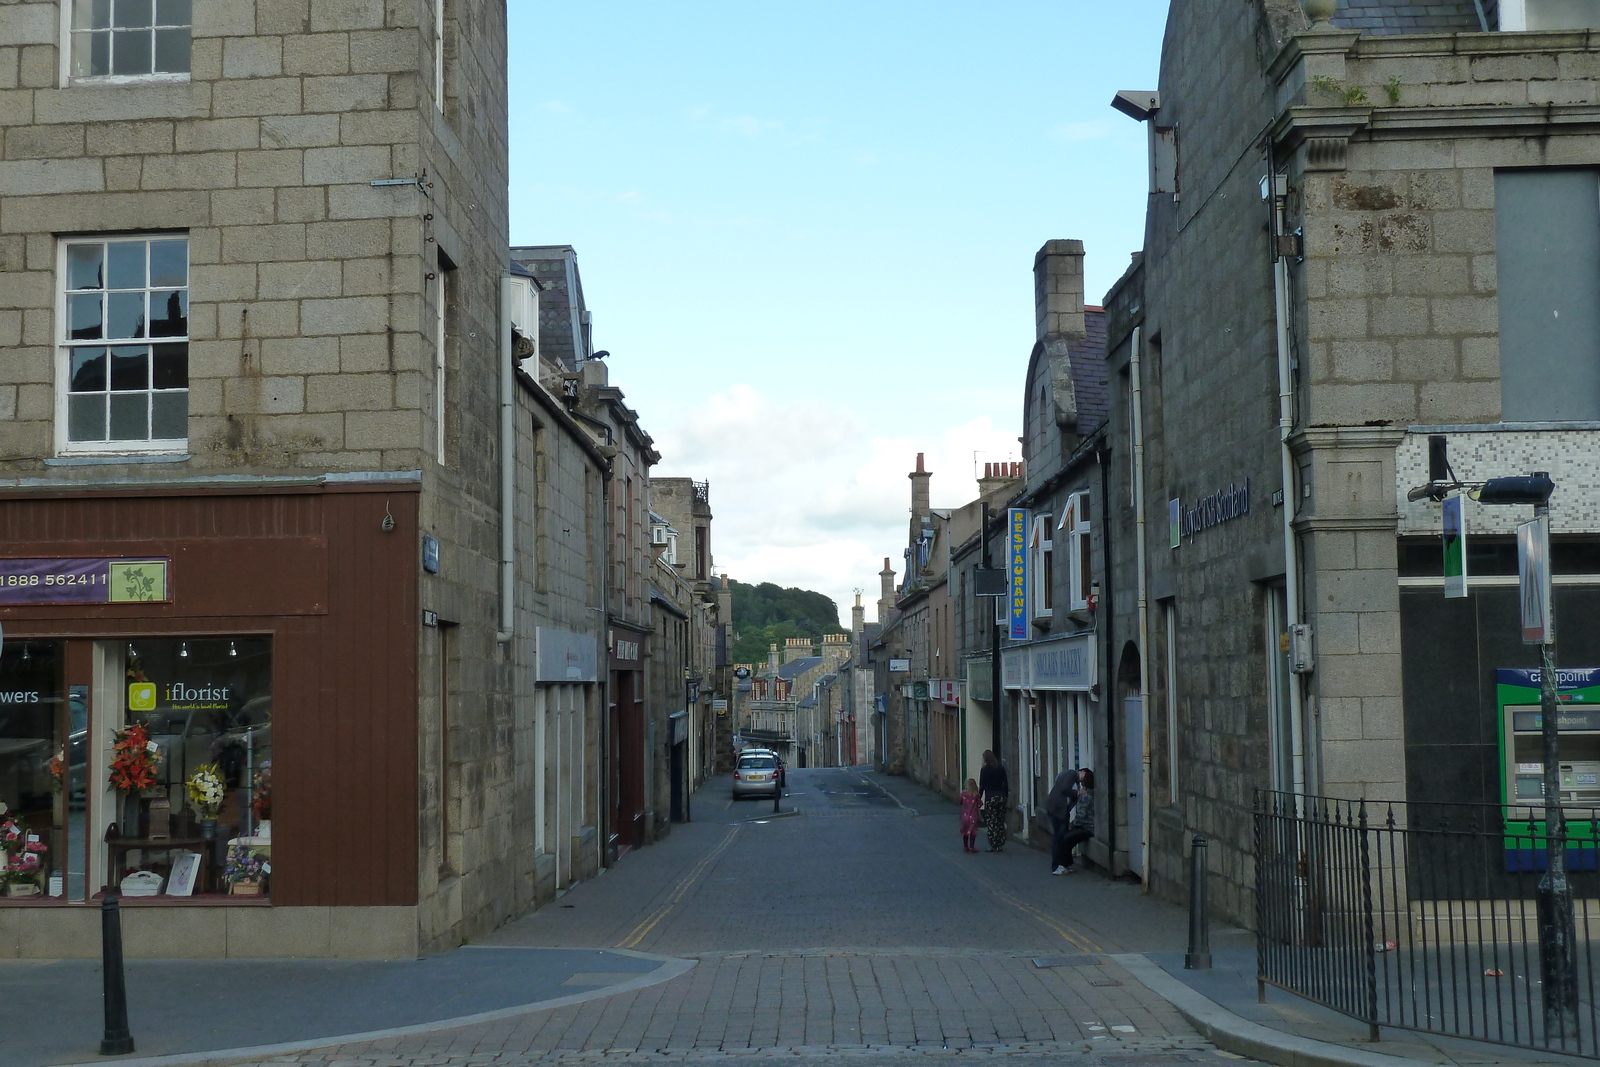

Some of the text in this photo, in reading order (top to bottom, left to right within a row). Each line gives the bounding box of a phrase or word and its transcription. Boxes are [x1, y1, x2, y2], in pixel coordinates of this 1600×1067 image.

[1202, 494, 1216, 529] TSB
[1217, 476, 1249, 523] Scotland
[45, 573, 107, 586] 562411
[1013, 512, 1024, 618] RESTAURANT
[165, 682, 230, 701] iflorist
